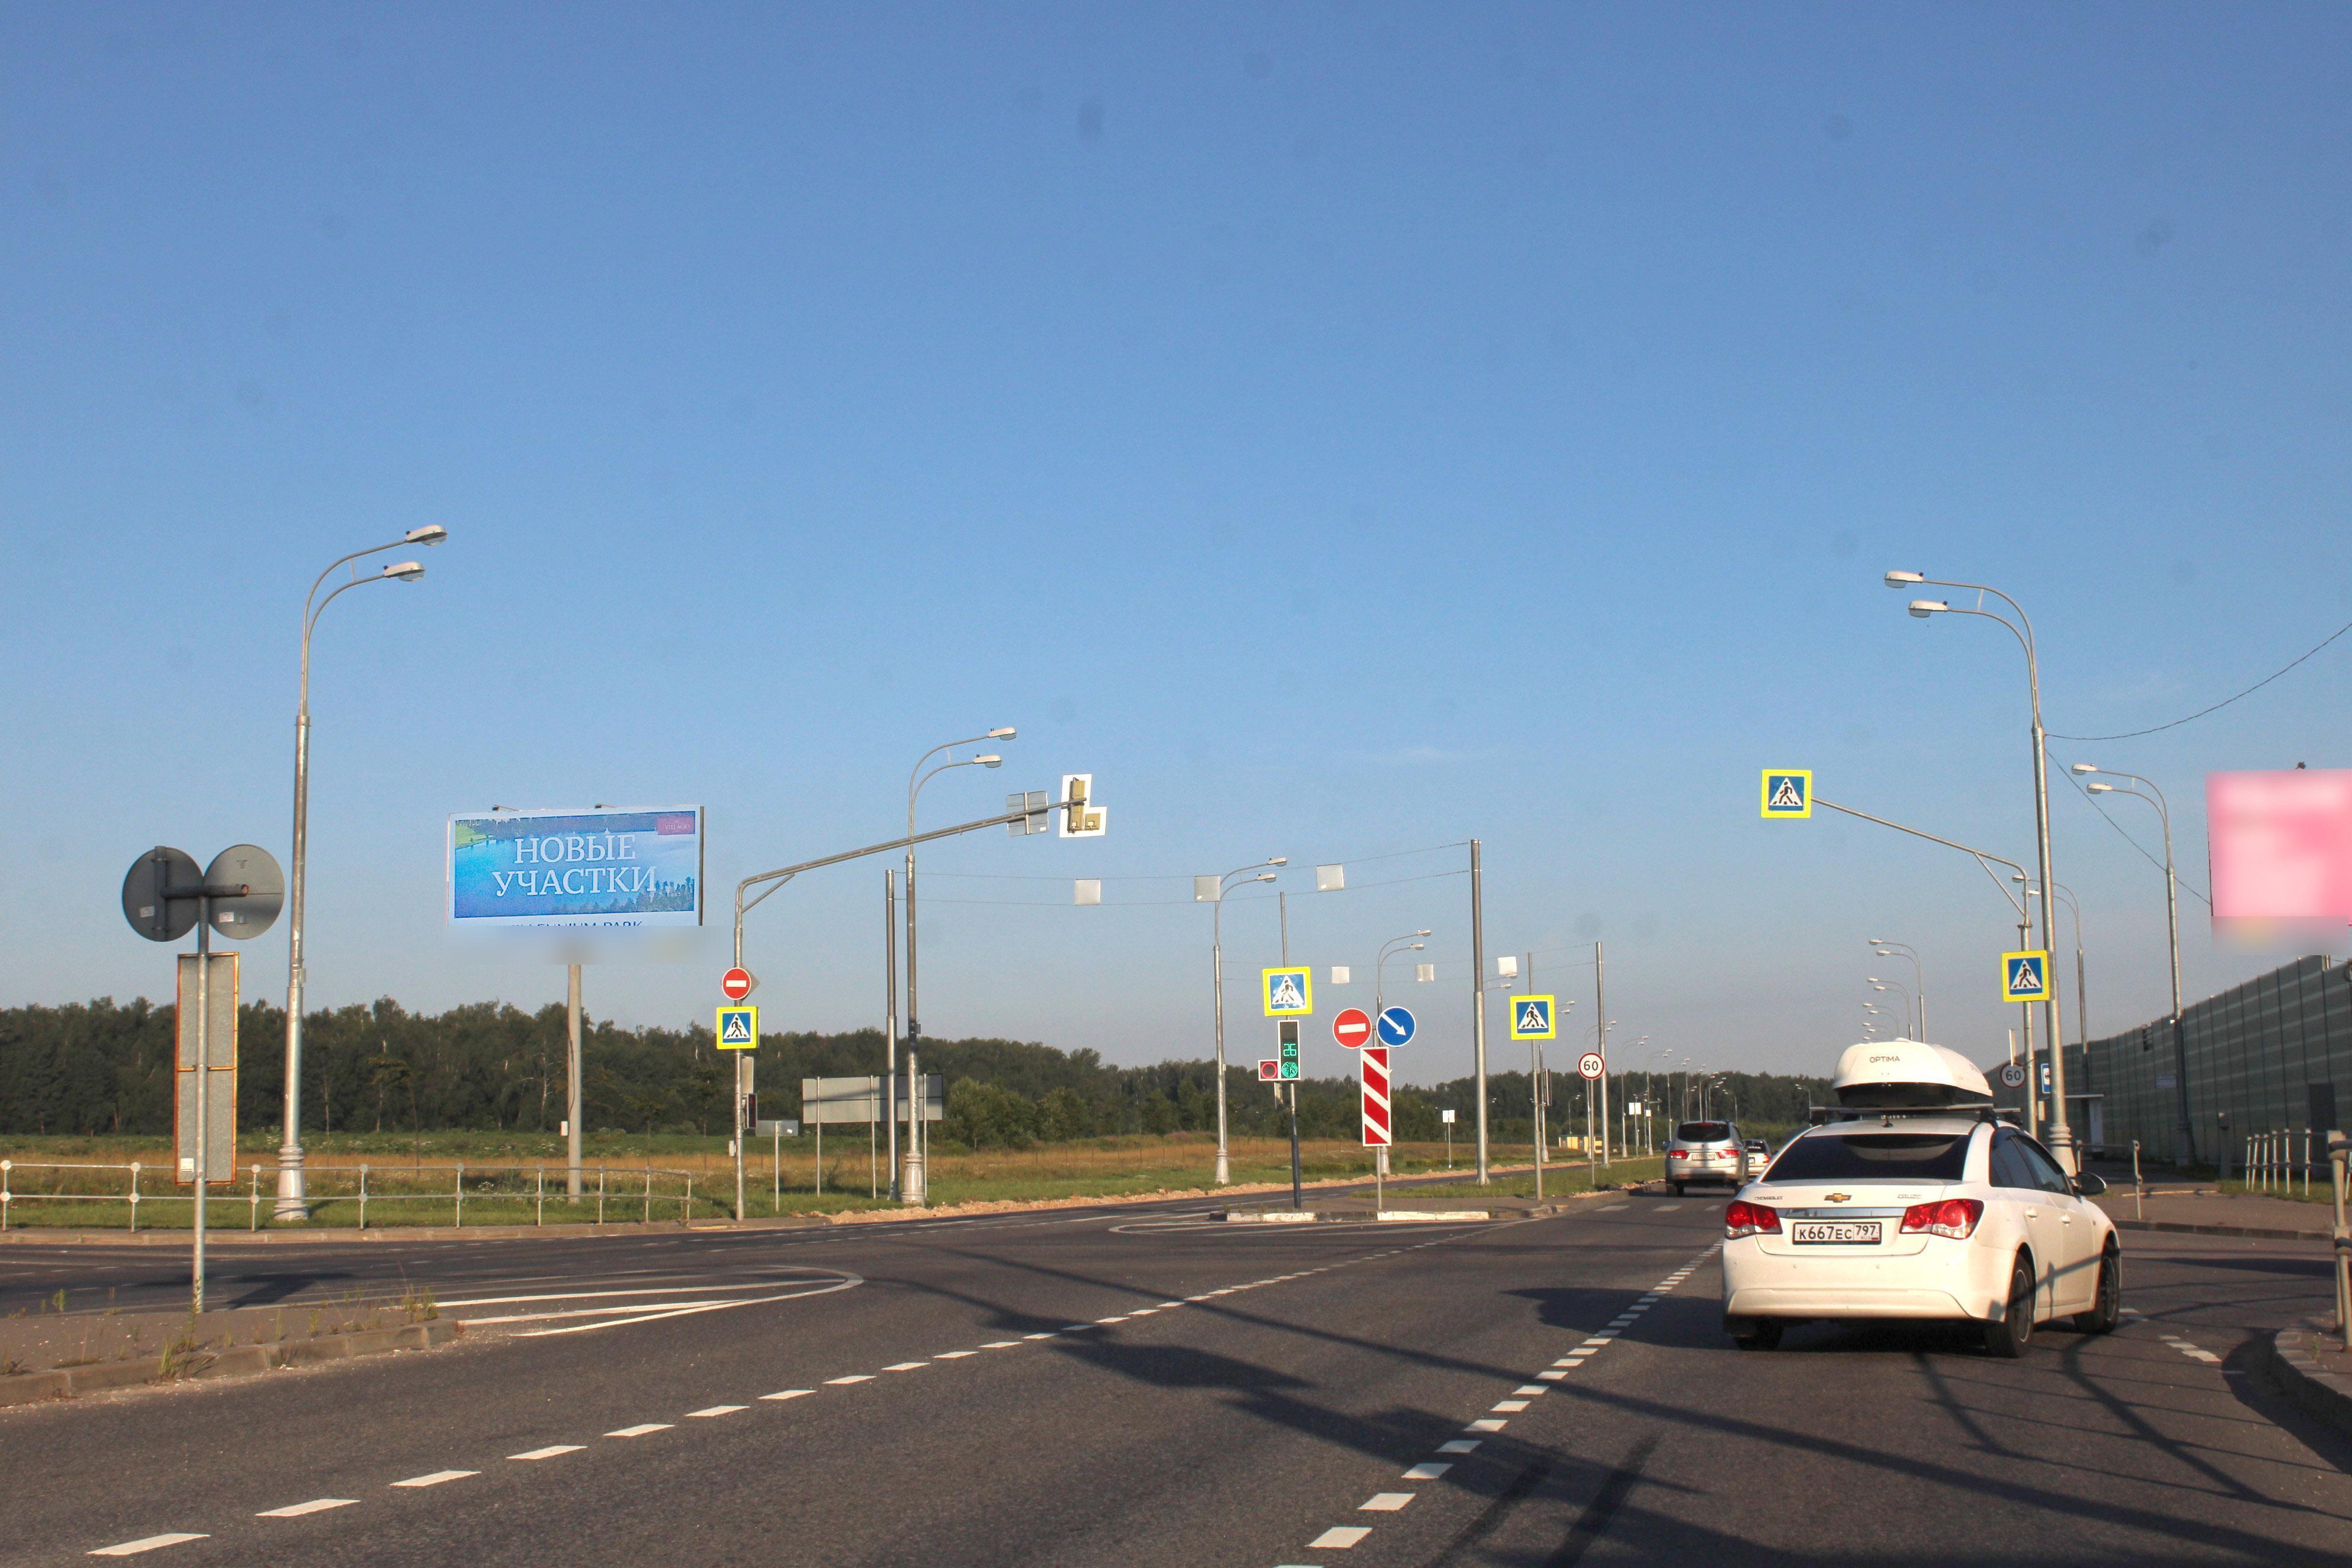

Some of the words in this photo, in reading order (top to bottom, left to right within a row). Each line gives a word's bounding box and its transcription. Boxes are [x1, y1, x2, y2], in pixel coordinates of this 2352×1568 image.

[514, 834, 636, 864] НОВЫЕ
[492, 866, 656, 897] УЧАСТКИ
[1283, 1043, 1297, 1057] 26
[1583, 1060, 1599, 1071] 60
[2005, 1070, 2021, 1081] 60
[1855, 1225, 1876, 1236] 797
